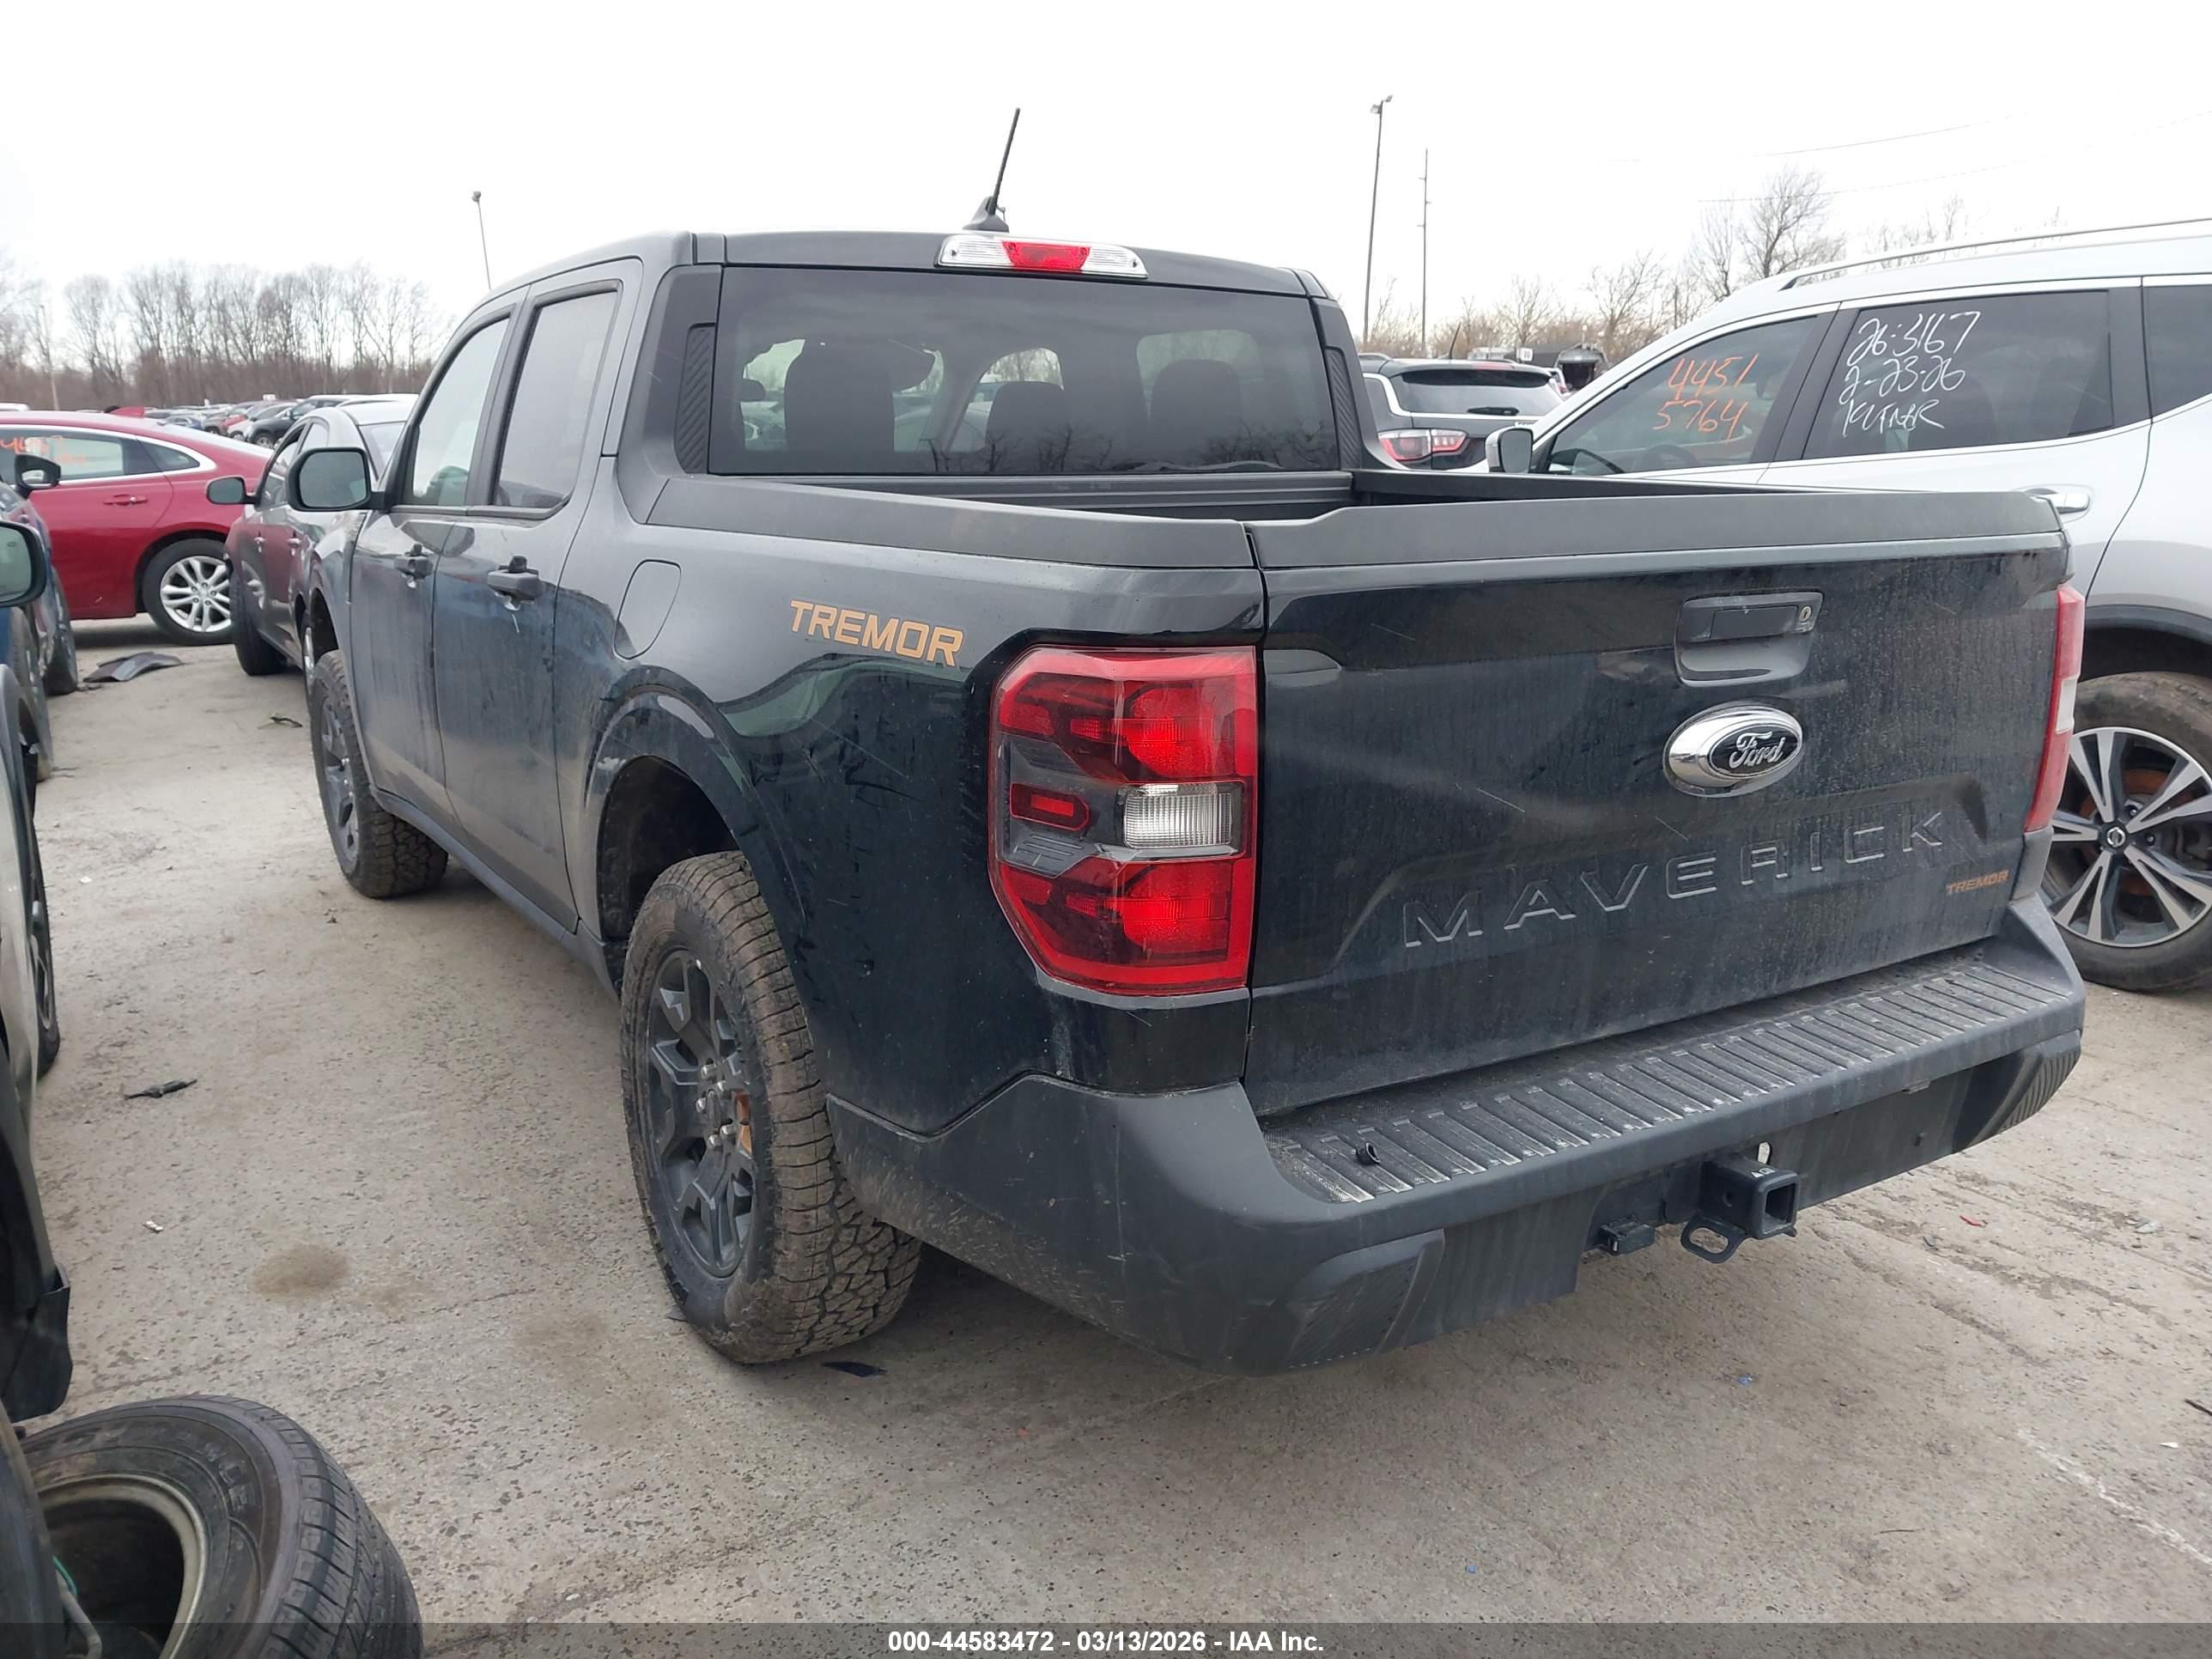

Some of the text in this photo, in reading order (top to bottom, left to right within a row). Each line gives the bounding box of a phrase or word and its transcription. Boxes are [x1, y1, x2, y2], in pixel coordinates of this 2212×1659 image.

[1668, 353, 1759, 400] 4451
[1838, 355, 1966, 404] 2-23-26
[1653, 398, 1749, 443] 5764
[790, 599, 963, 667] TREMOR
[1729, 731, 1785, 769] Ford
[1403, 811, 1944, 948] MAVERICK
[1945, 869, 2009, 895] TREMOR
